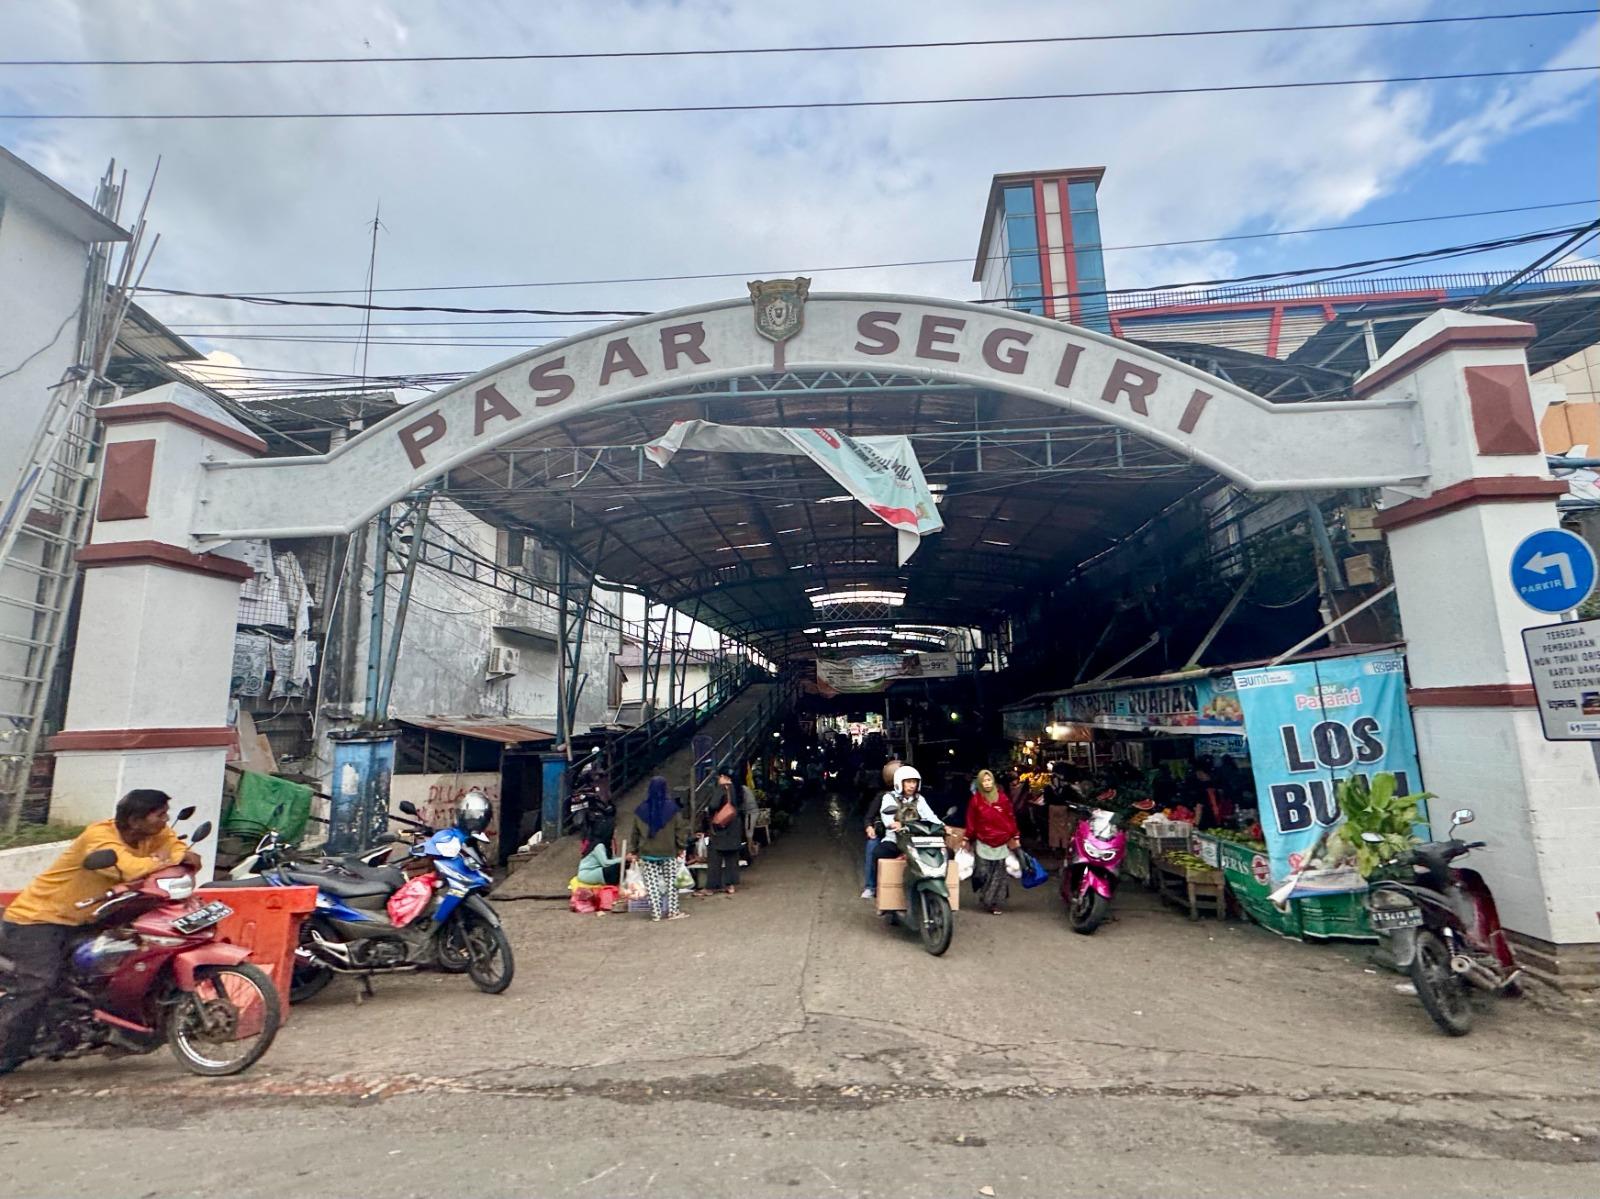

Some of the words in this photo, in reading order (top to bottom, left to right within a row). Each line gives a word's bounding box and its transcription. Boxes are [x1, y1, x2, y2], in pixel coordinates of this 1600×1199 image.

[397, 321, 711, 469] PASAR
[854, 311, 1214, 434] SEGIRI
[1520, 579, 1563, 594] PARKIR
[1546, 627, 1585, 640] TERSEDIA
[1542, 639, 1595, 653] PEMBAYARAN
[1279, 716, 1385, 774] LOS
